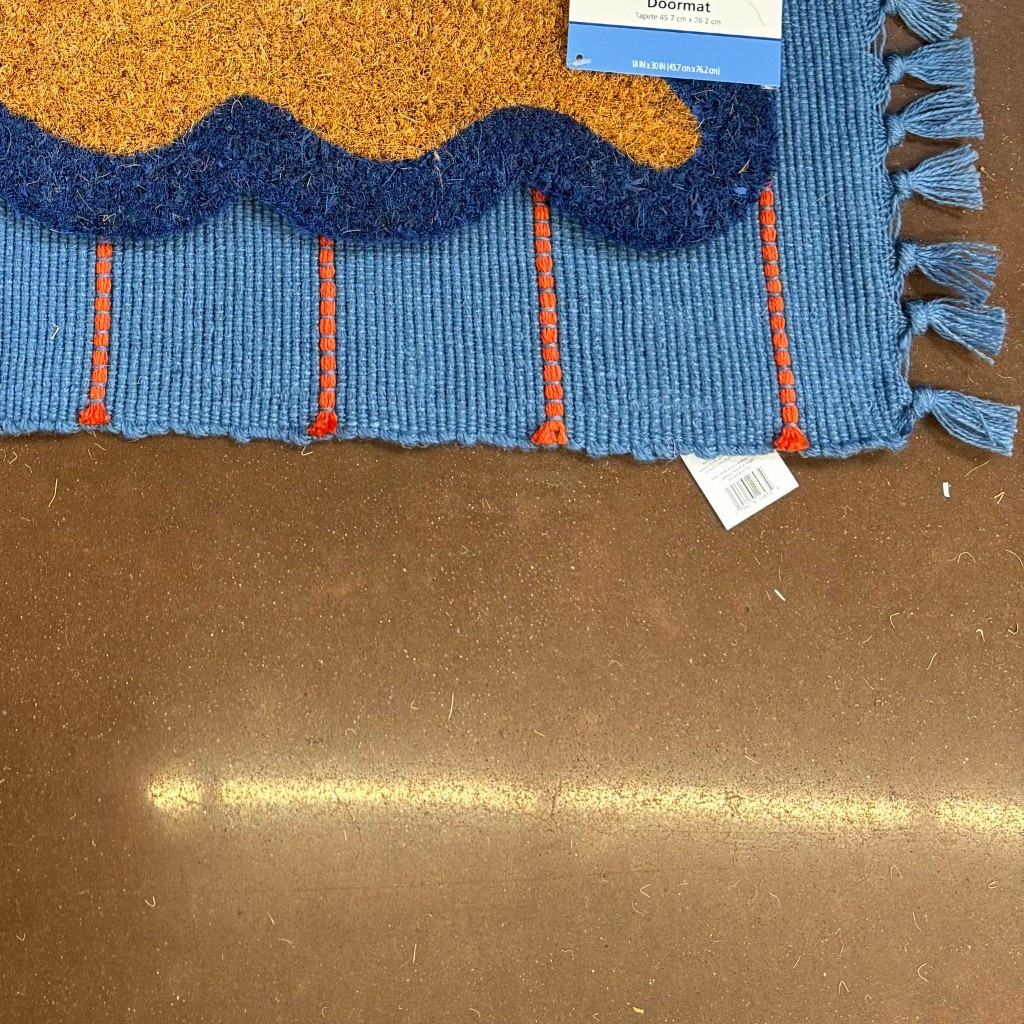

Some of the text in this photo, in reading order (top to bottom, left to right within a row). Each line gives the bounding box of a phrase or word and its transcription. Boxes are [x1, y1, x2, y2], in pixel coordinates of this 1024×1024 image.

[635, 11, 658, 21] Tapete
[631, 60, 638, 68] 18
[651, 61, 659, 70] 30
[666, 62, 682, 71] (45.7
[681, 65, 691, 73] cm
[696, 65, 709, 74] 76.2
